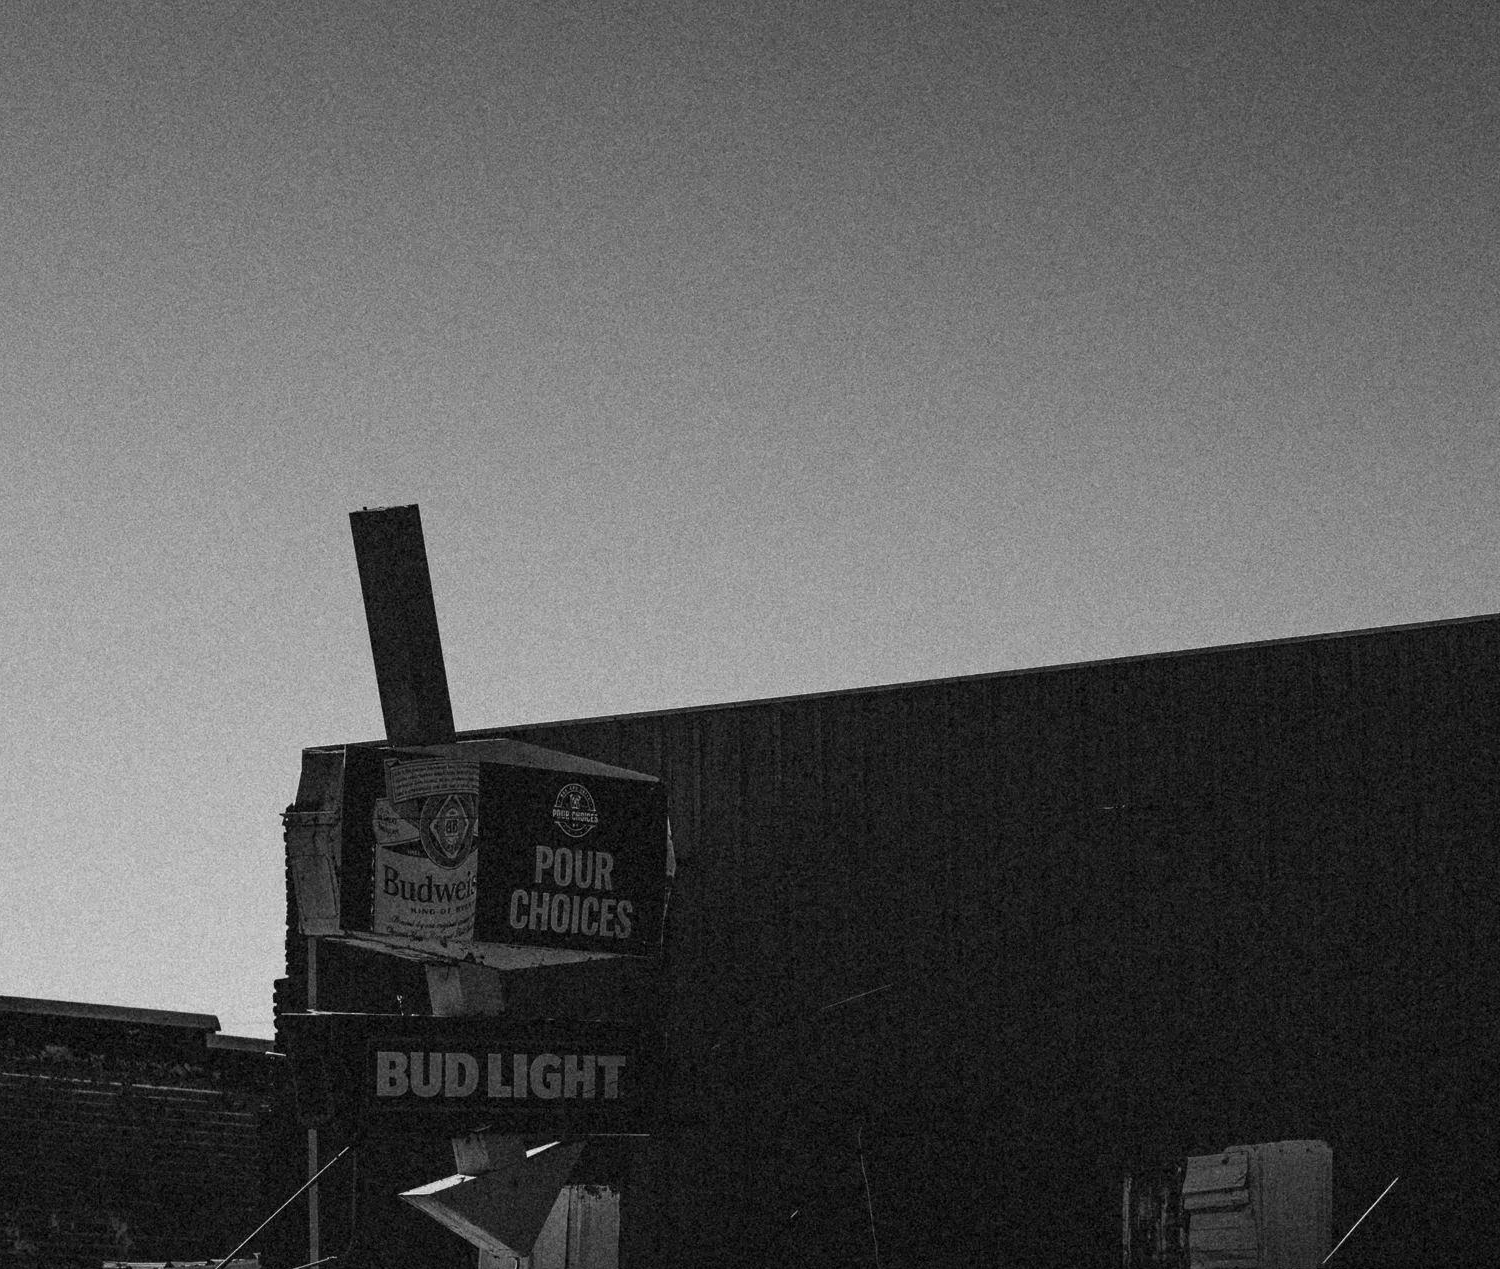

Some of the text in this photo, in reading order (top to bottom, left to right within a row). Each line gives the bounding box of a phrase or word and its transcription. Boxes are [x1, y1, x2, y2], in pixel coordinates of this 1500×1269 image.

[535, 845, 614, 891] POUR
[509, 889, 634, 940] CHOICES
[376, 1050, 627, 1100] BUD LIGHT
